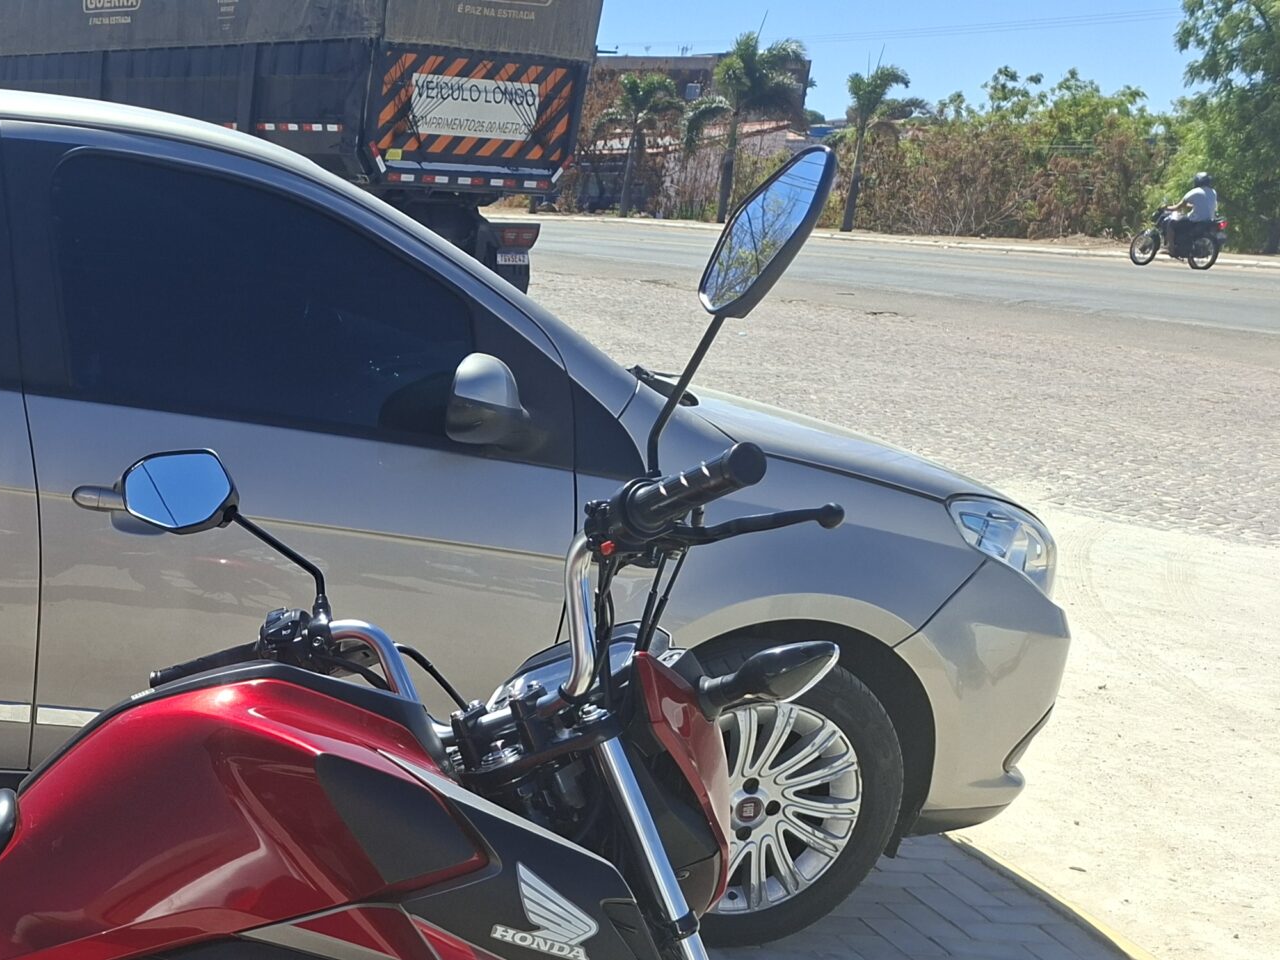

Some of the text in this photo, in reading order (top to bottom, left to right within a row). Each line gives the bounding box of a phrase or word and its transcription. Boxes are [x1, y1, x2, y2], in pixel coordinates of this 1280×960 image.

[465, 6, 482, 15] PAZ
[483, 8, 496, 17] NA
[497, 9, 536, 20] ESTRADA
[484, 84, 537, 108] LONGO
